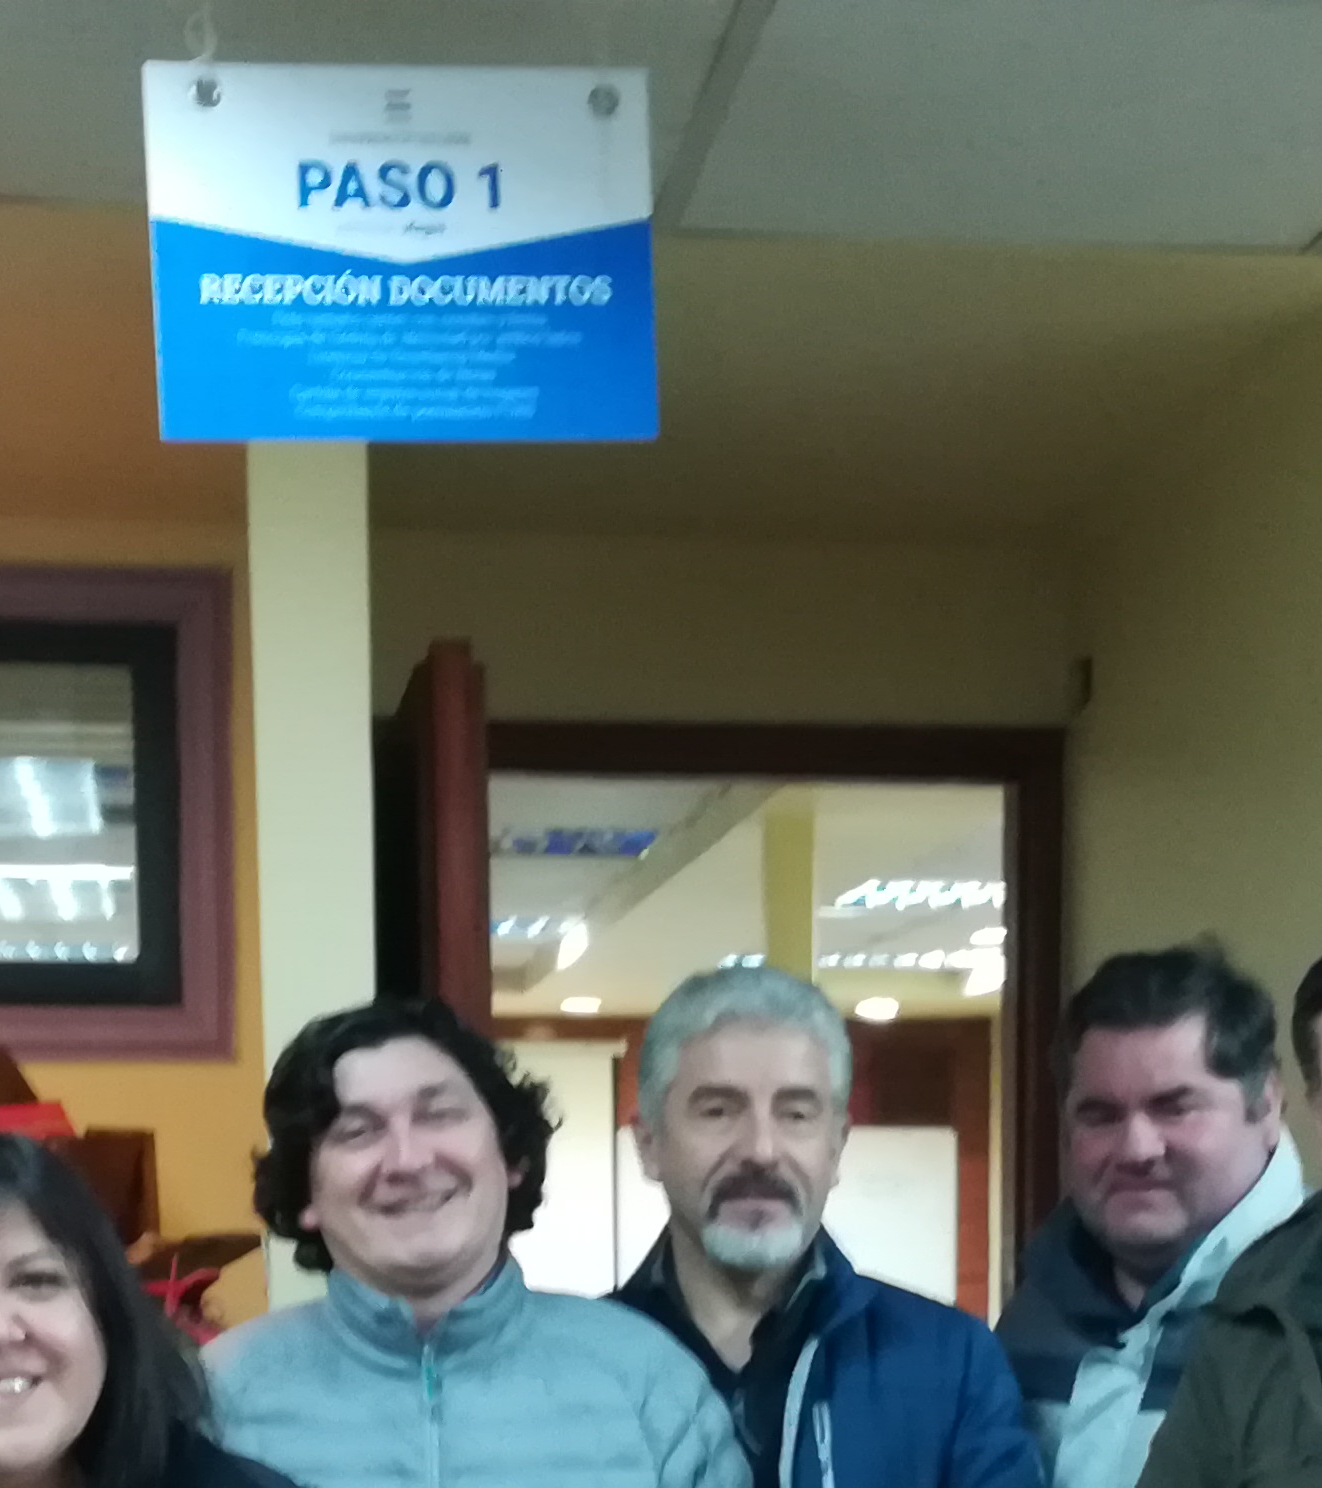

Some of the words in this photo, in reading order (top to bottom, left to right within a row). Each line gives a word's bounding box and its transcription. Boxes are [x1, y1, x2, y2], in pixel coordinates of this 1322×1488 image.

[297, 159, 456, 210] PASO
[477, 161, 502, 210] 1
[199, 270, 383, 306] RECEPCIÓN
[388, 274, 614, 307] DOCUMENTOS
